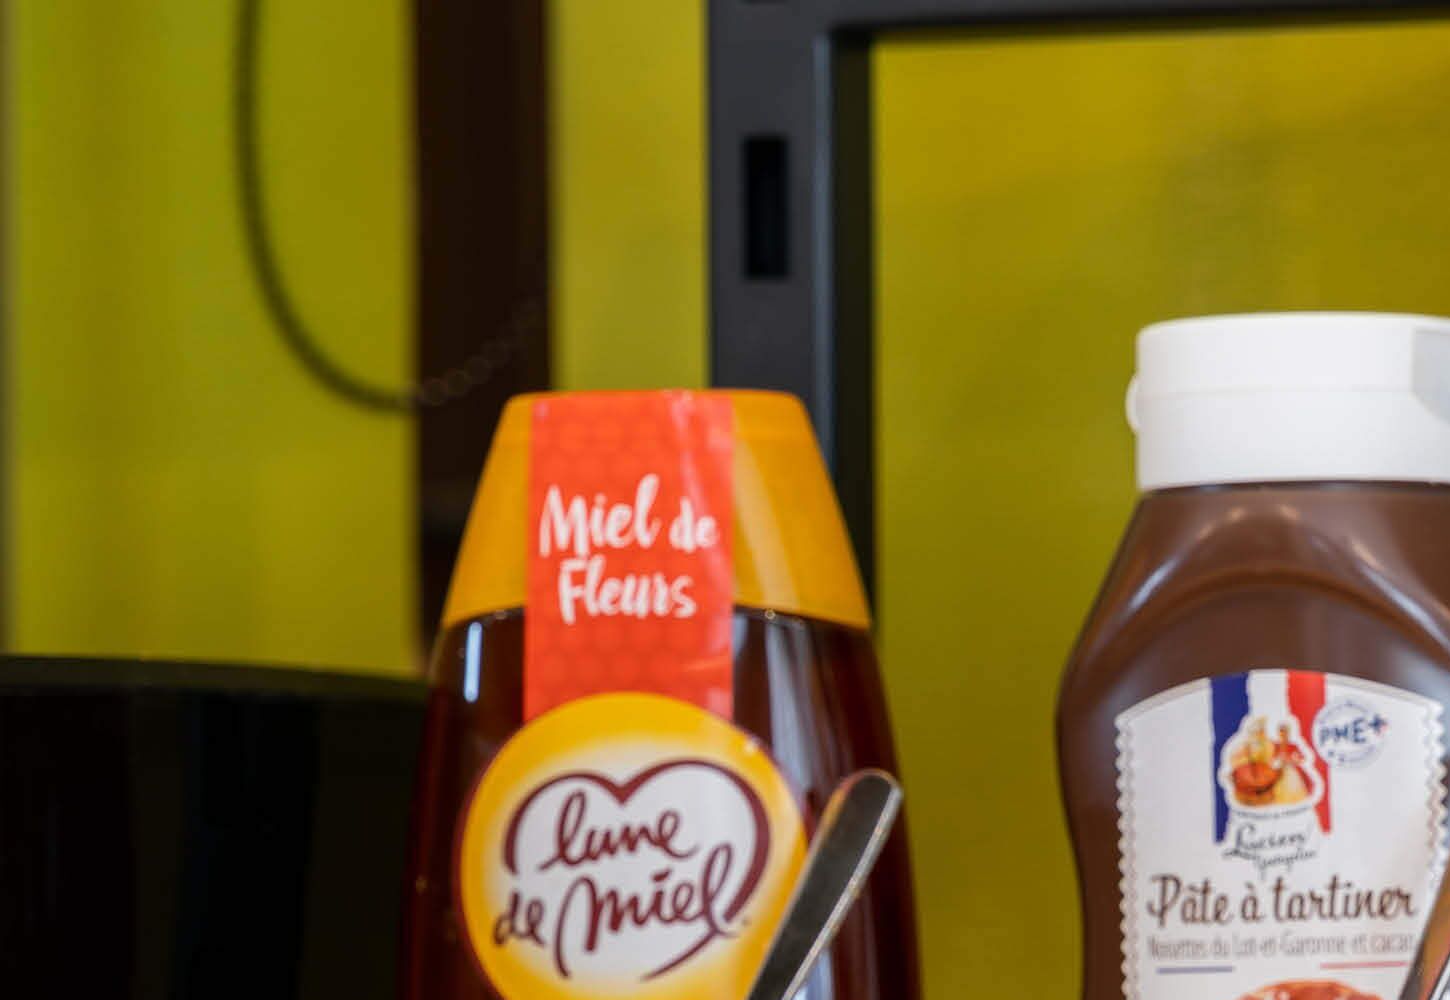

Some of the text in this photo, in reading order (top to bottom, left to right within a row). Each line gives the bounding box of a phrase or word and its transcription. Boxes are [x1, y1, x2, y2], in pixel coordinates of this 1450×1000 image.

[540, 473, 720, 557] Miel de
[558, 556, 698, 625] Fleurs
[540, 790, 699, 871] lune
[493, 844, 734, 980] de miel
[1147, 873, 1418, 929] Pâte à tartiner
